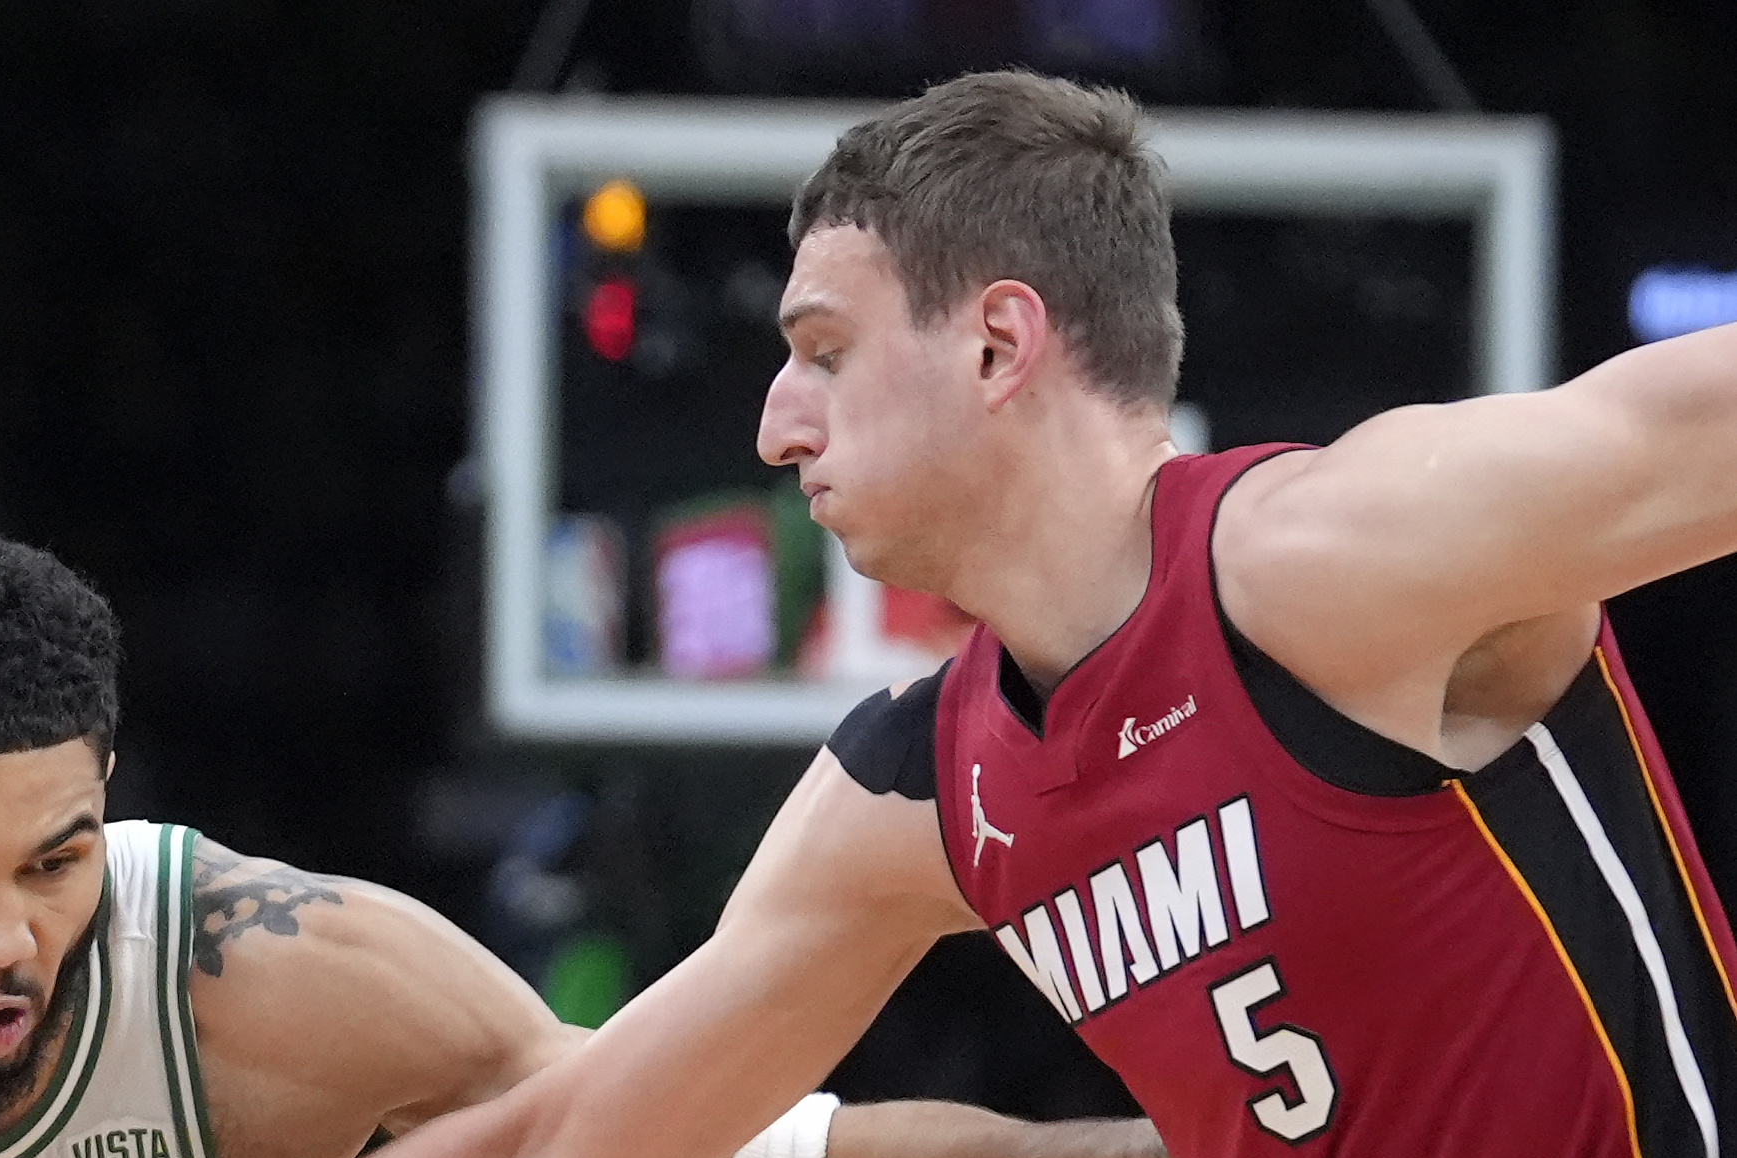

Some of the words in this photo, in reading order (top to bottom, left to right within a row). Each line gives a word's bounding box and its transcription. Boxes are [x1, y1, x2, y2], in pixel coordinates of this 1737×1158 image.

[1134, 694, 1197, 746] Carnival
[993, 794, 1270, 1026] MIAMI
[1208, 955, 1337, 1145] 5
